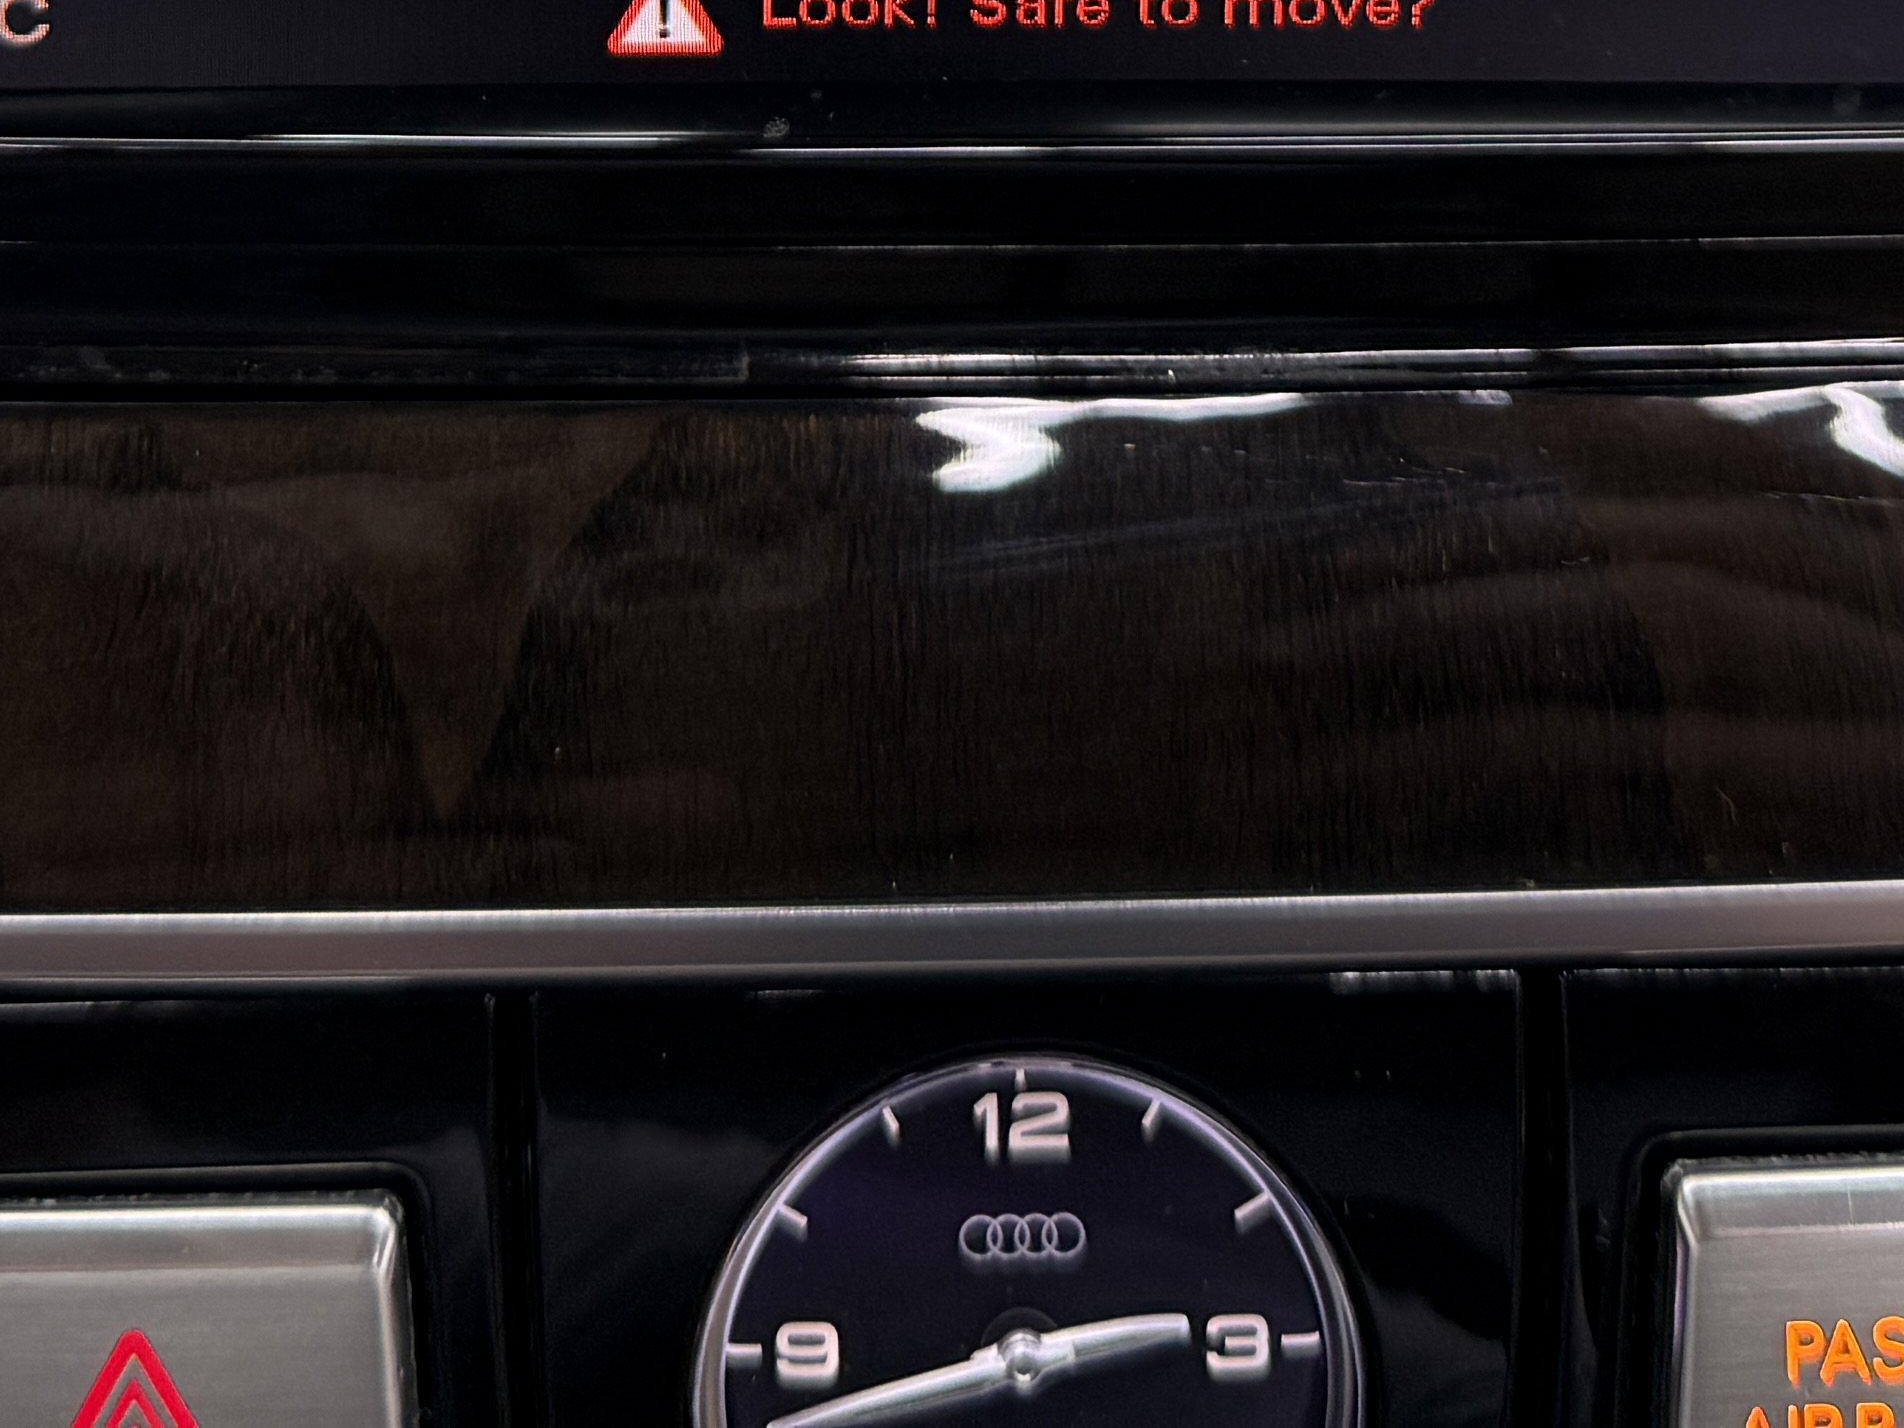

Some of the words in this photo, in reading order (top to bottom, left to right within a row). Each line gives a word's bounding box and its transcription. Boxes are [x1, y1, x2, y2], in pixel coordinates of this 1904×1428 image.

[972, 1090, 1072, 1161] 12
[775, 1320, 840, 1382] 9
[1205, 1312, 1270, 1376] 3
